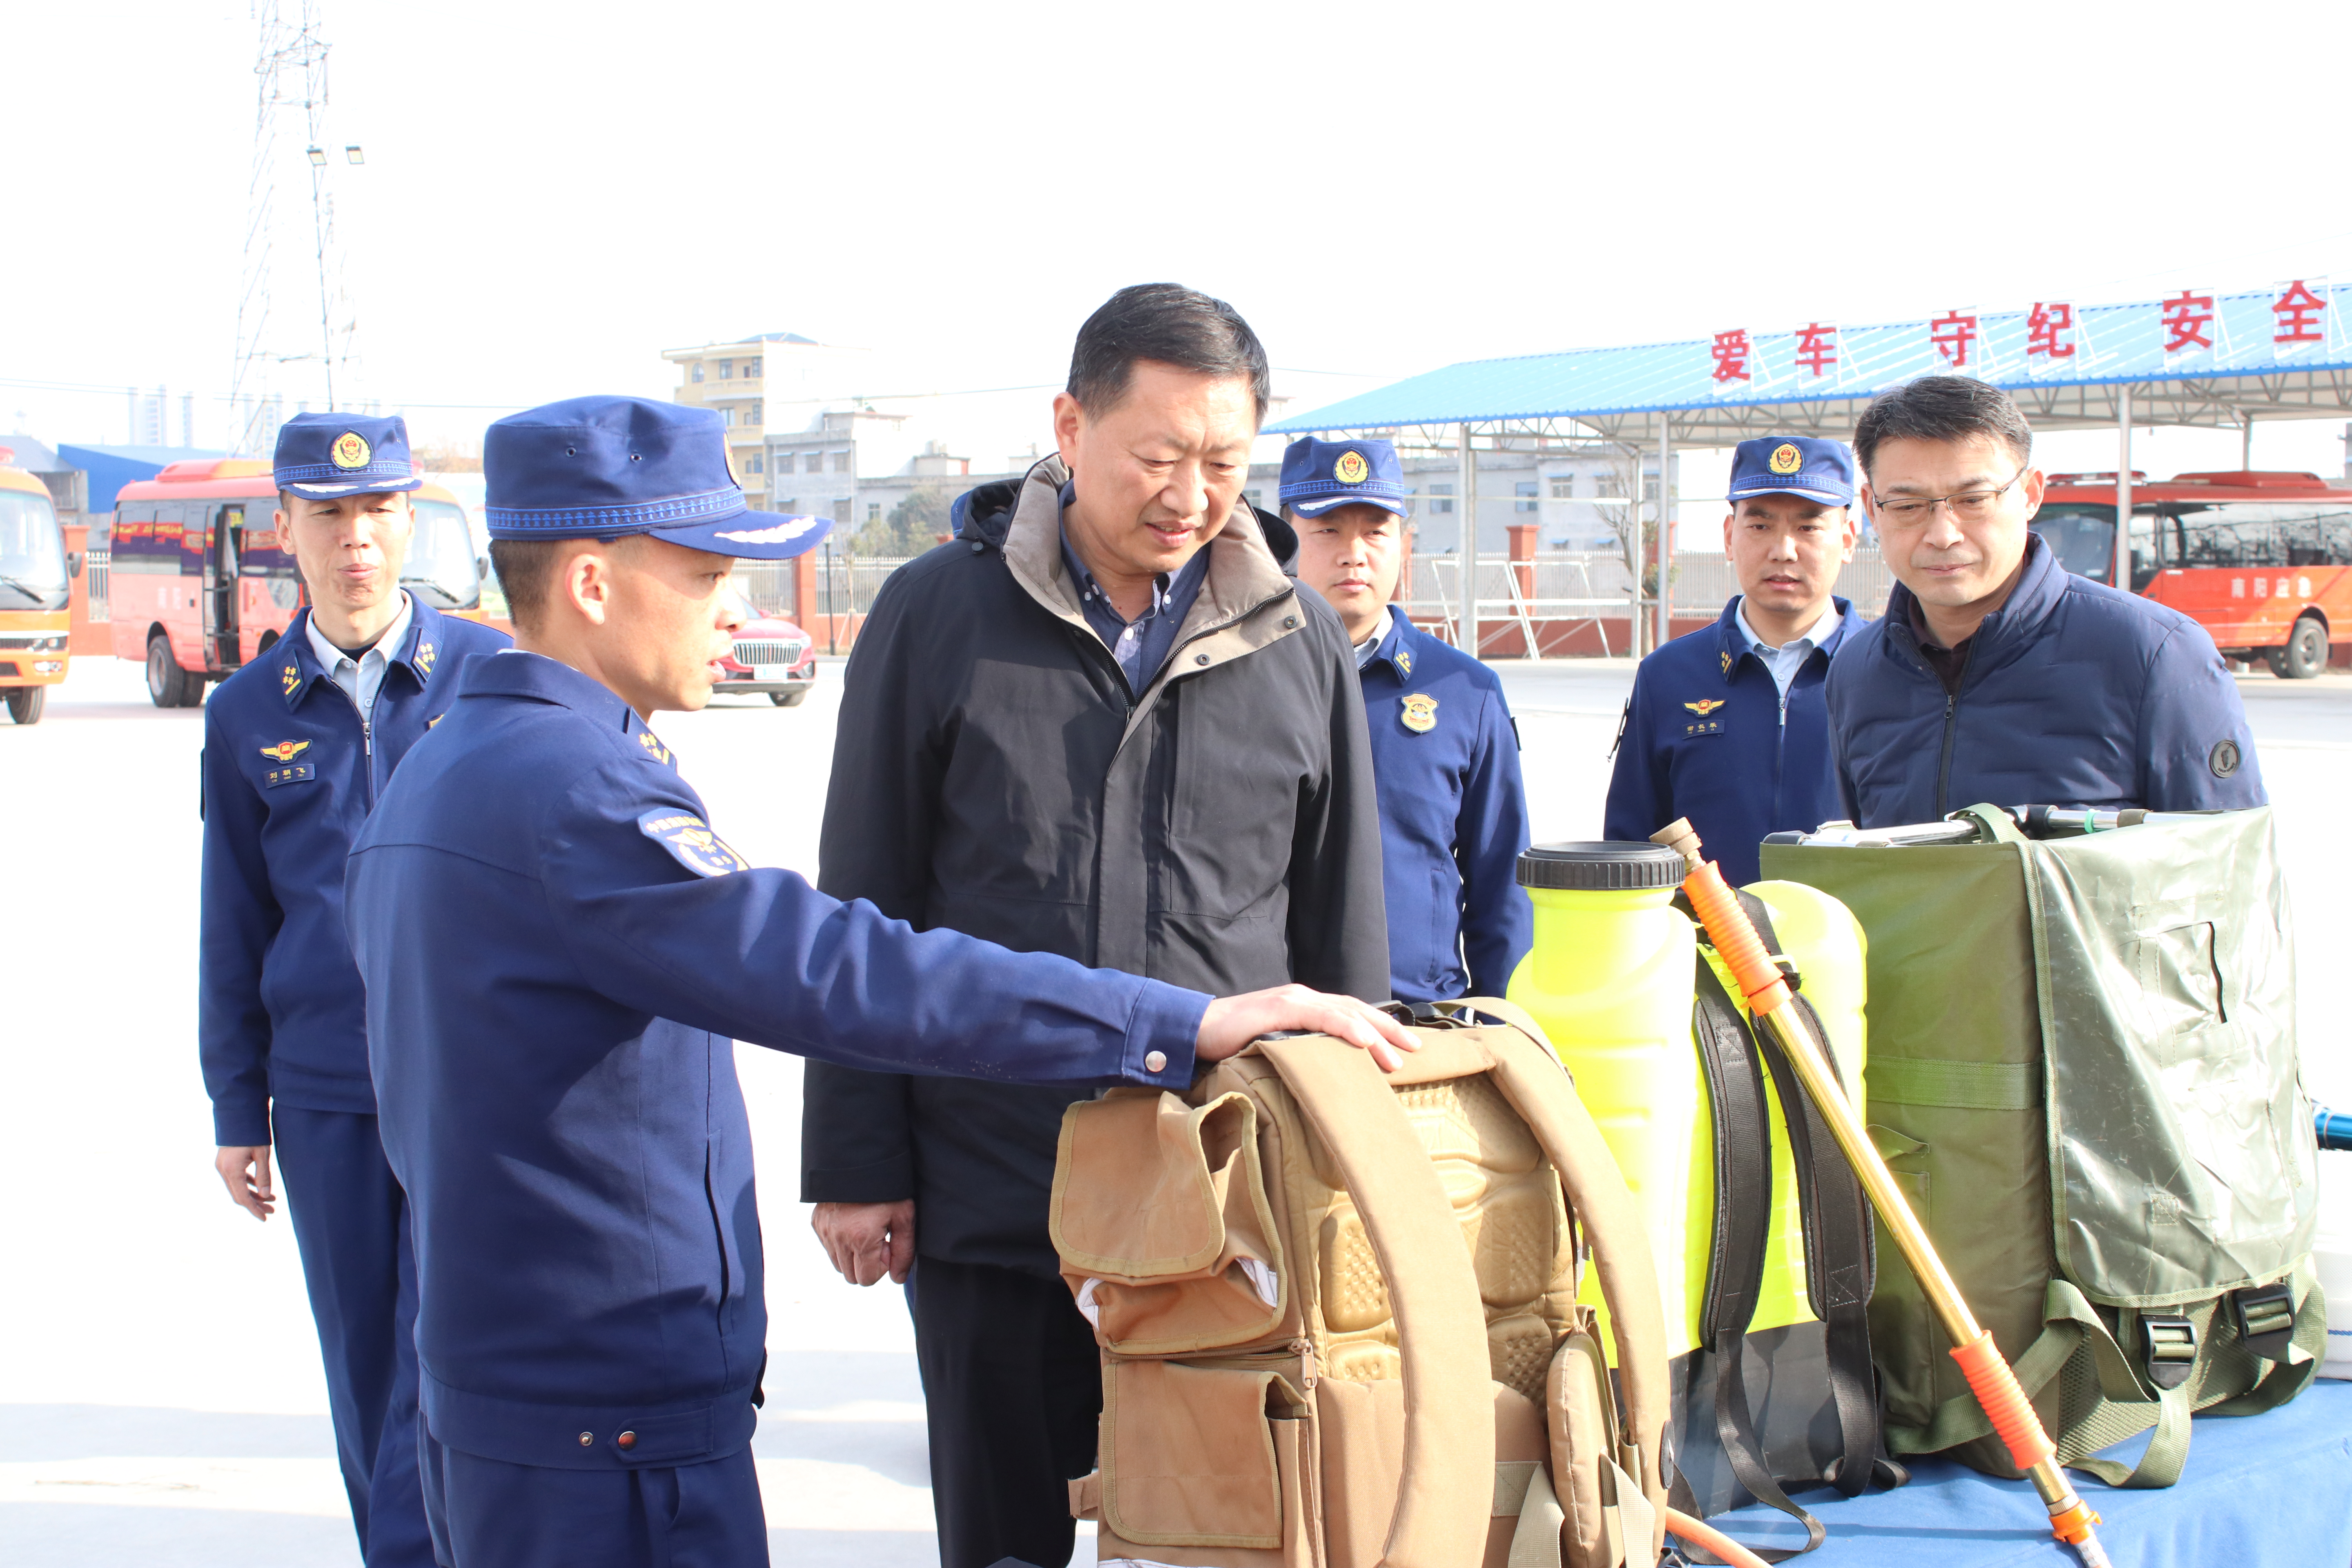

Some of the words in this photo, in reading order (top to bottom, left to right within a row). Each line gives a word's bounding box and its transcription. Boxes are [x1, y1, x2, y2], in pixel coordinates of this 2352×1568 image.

[1712, 280, 2325, 381] 爱车守纪安全
